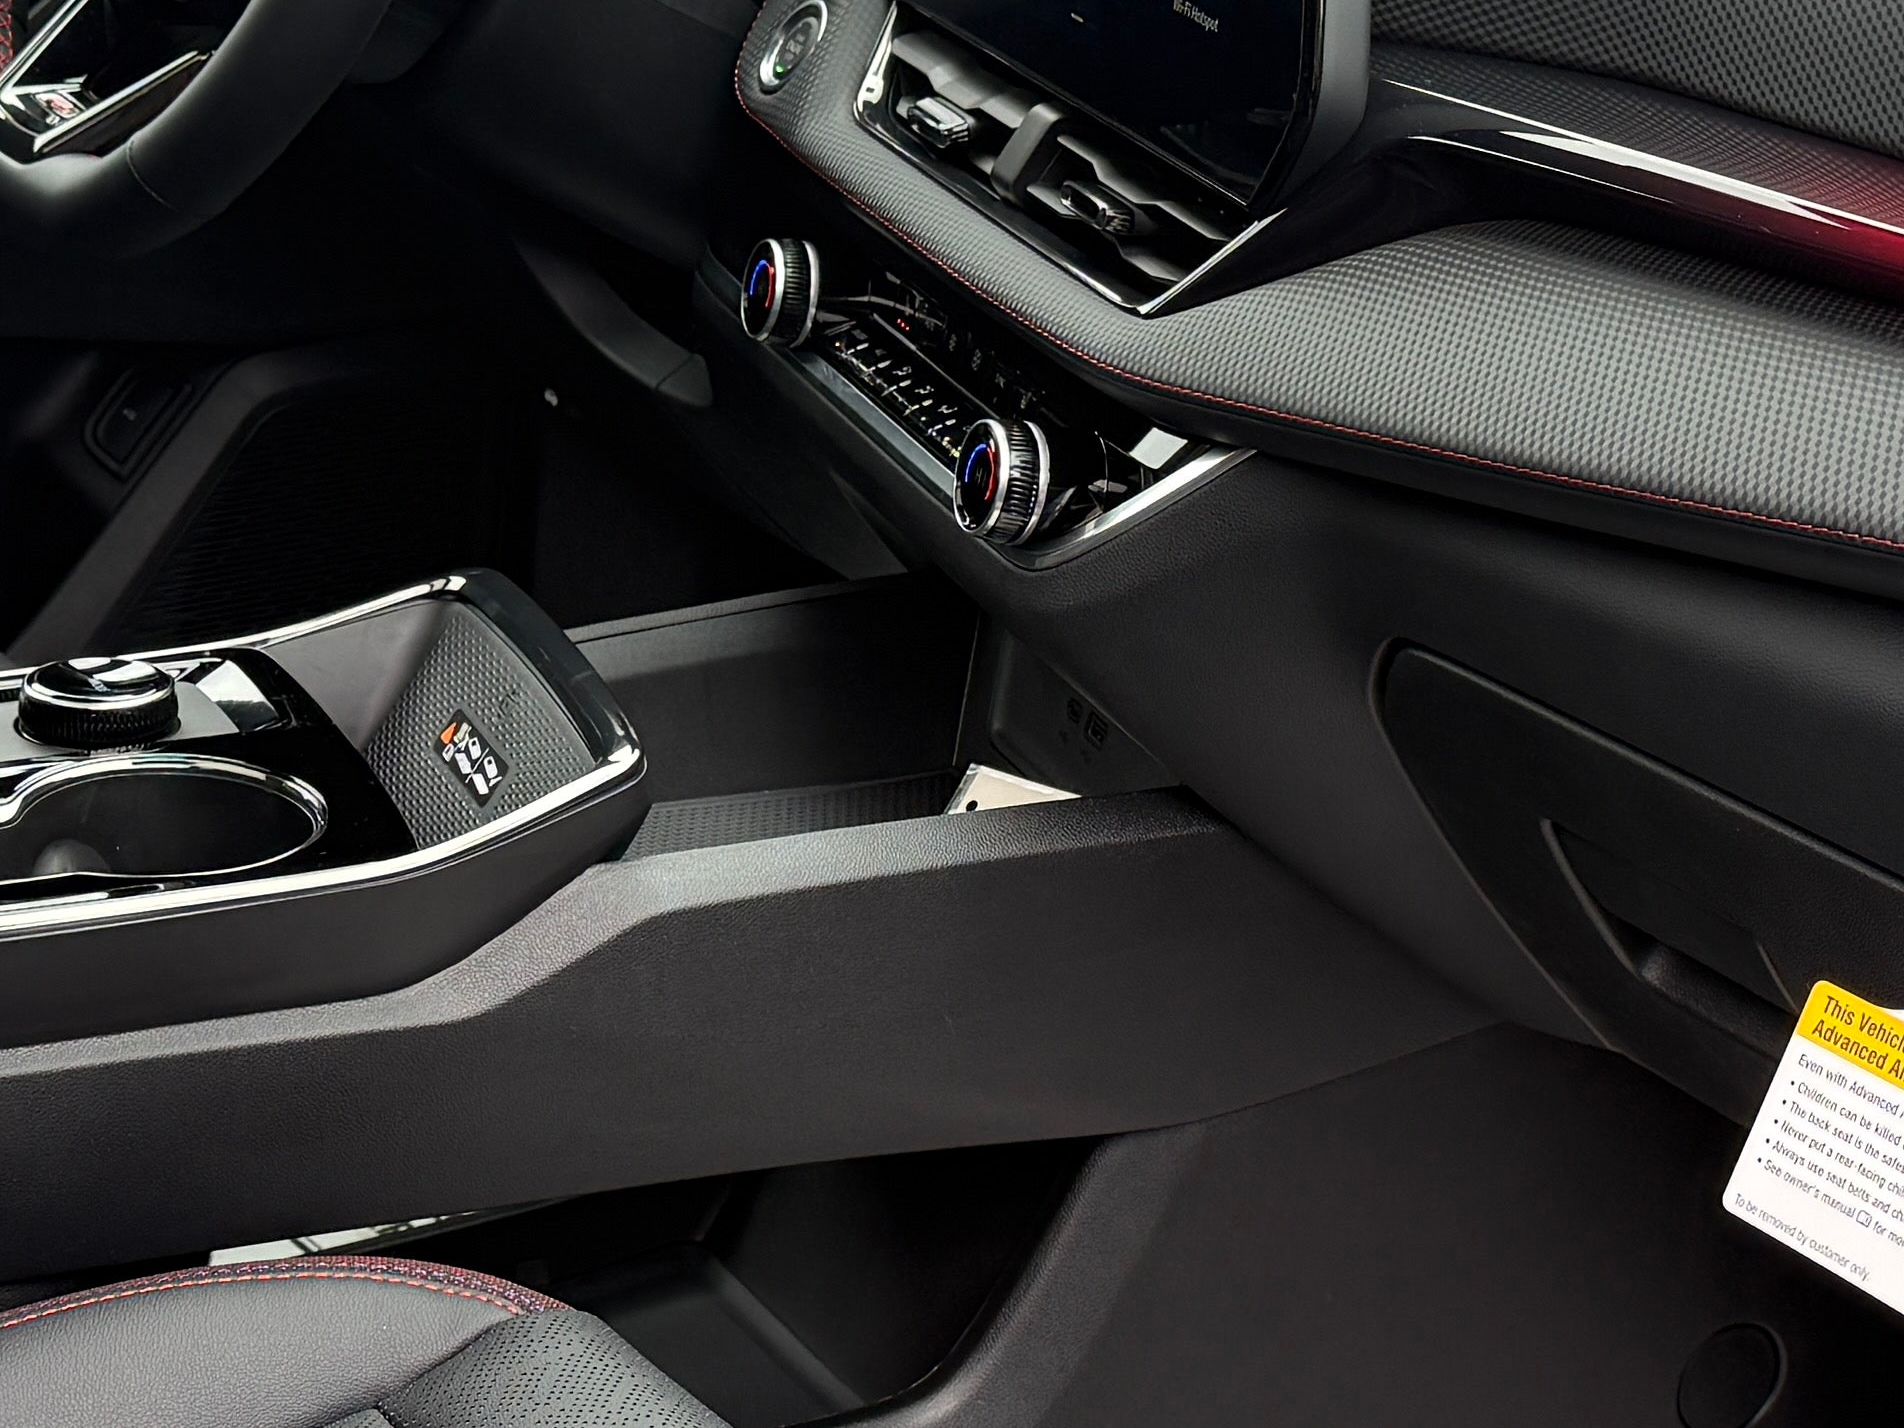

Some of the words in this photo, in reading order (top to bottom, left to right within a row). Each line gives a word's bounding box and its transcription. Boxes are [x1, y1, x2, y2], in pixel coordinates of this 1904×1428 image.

[1823, 995, 1856, 1026] This
[1811, 1018, 1889, 1071] Advanced
[1797, 1081, 1838, 1113] Children
[1839, 1107, 1858, 1123] can
[1859, 1115, 1872, 1131] be
[1873, 1122, 1903, 1147] killed
[1798, 1053, 1824, 1077] Even
[1825, 1069, 1848, 1089] with
[1848, 1080, 1900, 1116] Advanced
[1780, 1120, 1809, 1143] Never
[1808, 1138, 1827, 1154] put
[1826, 1148, 1834, 1158] a
[1834, 1152, 1887, 1189] rear-facing
[1790, 1100, 1807, 1119] The
[1807, 1111, 1832, 1133] back
[1831, 1127, 1854, 1145] seat
[1854, 1136, 1864, 1150] is
[1864, 1142, 1880, 1160] the
[1763, 1159, 1782, 1178] See
[1783, 1171, 1821, 1199] owner's
[1820, 1193, 1857, 1219] manual
[1872, 1220, 1887, 1236] for
[1771, 1140, 1806, 1167] Always
[1807, 1160, 1825, 1178] use
[1825, 1171, 1847, 1190] seat
[1847, 1181, 1872, 1203] belts
[1871, 1197, 1892, 1214] and
[1734, 1192, 1746, 1208] To
[1745, 1199, 1759, 1216] be
[1757, 1209, 1798, 1238] removed
[1796, 1229, 1809, 1247] by
[1809, 1238, 1850, 1268] customer
